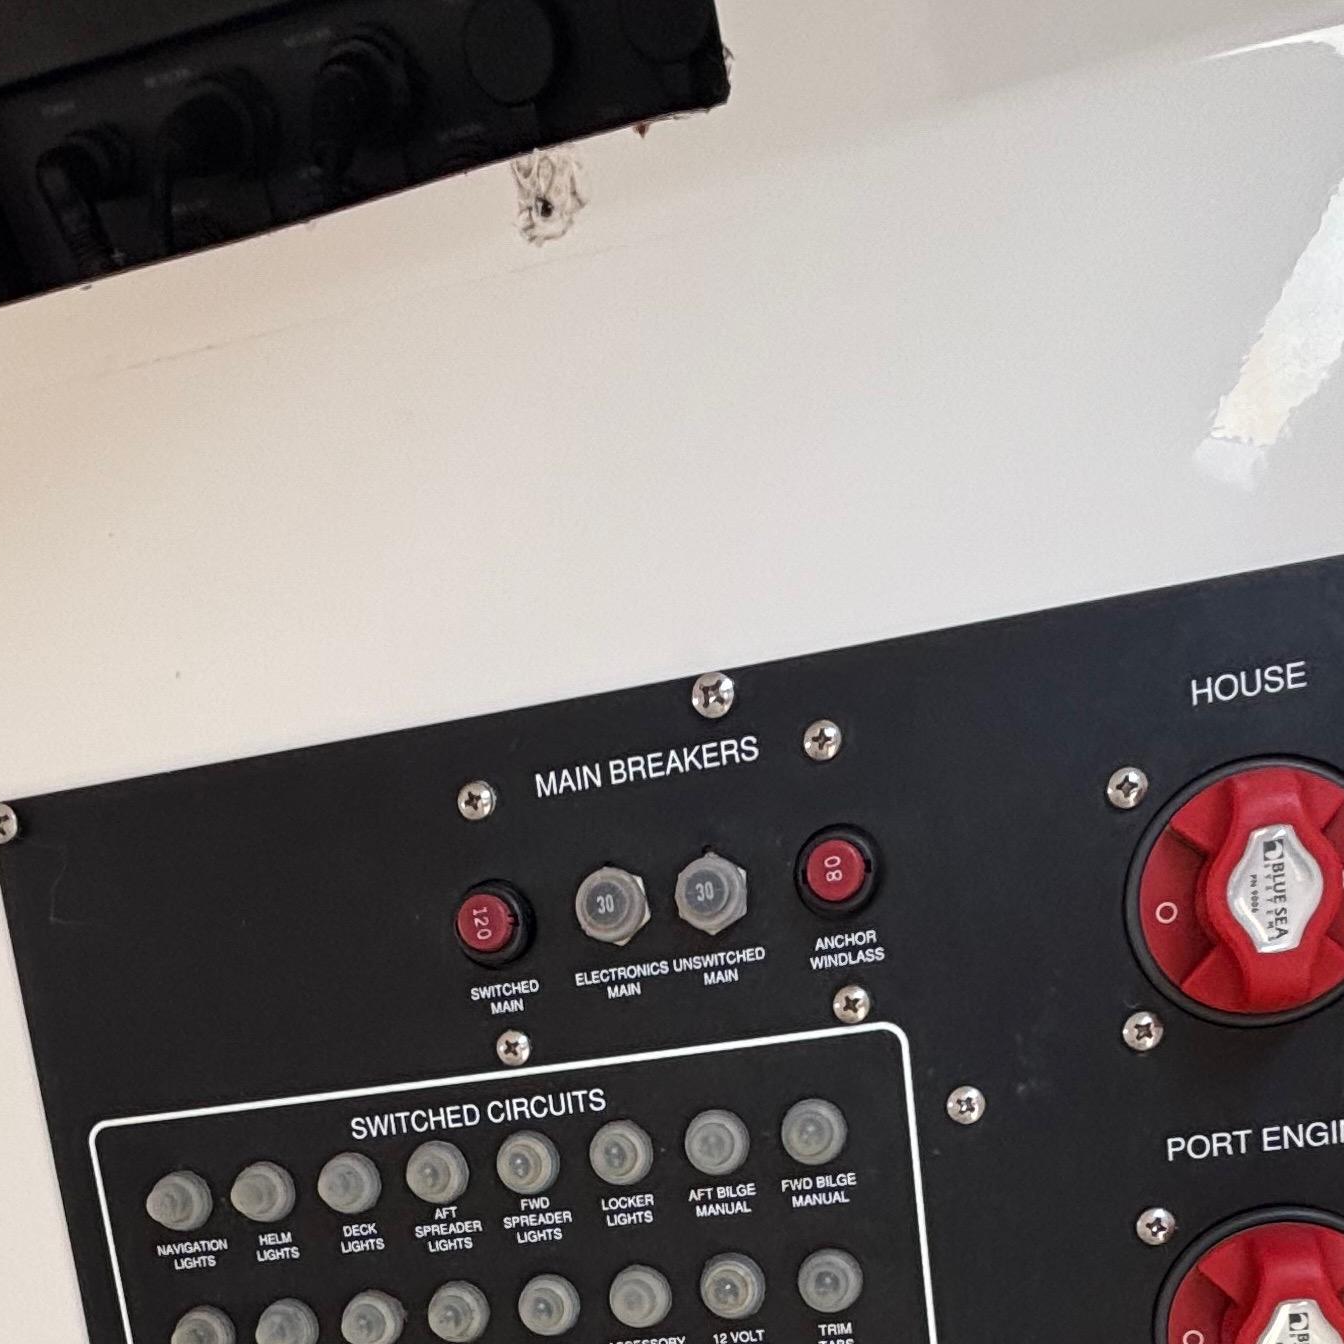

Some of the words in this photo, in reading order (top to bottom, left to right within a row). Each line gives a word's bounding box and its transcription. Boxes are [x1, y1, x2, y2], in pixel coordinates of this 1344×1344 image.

[1191, 661, 1307, 706] HOUSE
[535, 763, 601, 797] MAIN
[609, 736, 759, 784] BREAKERS
[695, 880, 716, 902] 30
[1272, 862, 1287, 904] BLUE
[596, 892, 616, 915] 30
[471, 906, 494, 941] 120
[1274, 906, 1289, 941] SEA
[815, 930, 877, 951] ANCHOR
[673, 947, 765, 972] UNSWITCHED
[810, 947, 885, 969] WINDLASS
[575, 961, 669, 986] ELECTRONICS
[704, 968, 738, 985] MAIN
[471, 980, 539, 1000] SWITCHED
[607, 982, 641, 998] MAIN
[491, 998, 524, 1014] MAIN
[351, 1104, 480, 1139] SWITCHED
[487, 1088, 606, 1123] CIRCUITS
[1167, 1130, 1252, 1161] PORT
[782, 1177, 813, 1192] FWD
[816, 1173, 856, 1188] BILGE
[689, 1188, 713, 1201] AFT
[717, 1183, 756, 1198] BILGE
[792, 1191, 850, 1207] MANUAL
[521, 1197, 549, 1210] FWD
[602, 1194, 654, 1210] LOCKER
[696, 1201, 752, 1217] MANUAL
[435, 1206, 457, 1219] AFT
[503, 1211, 572, 1229] SPREADER
[607, 1210, 653, 1226] LIGHTS
[343, 1223, 377, 1237] DECK
[415, 1220, 482, 1238] SPREADER
[517, 1228, 562, 1243] LIGHTS
[259, 1232, 292, 1245] HELM
[341, 1238, 385, 1253] LIGHTS
[428, 1237, 473, 1252] LIGHTS
[157, 1239, 227, 1256] NAVIGATION
[257, 1247, 300, 1261] LIGHTS
[174, 1255, 216, 1270] LIGHTS
[713, 1333, 727, 1344] 12
[730, 1330, 765, 1343] VOLT
[818, 1322, 852, 1336] TRIM
